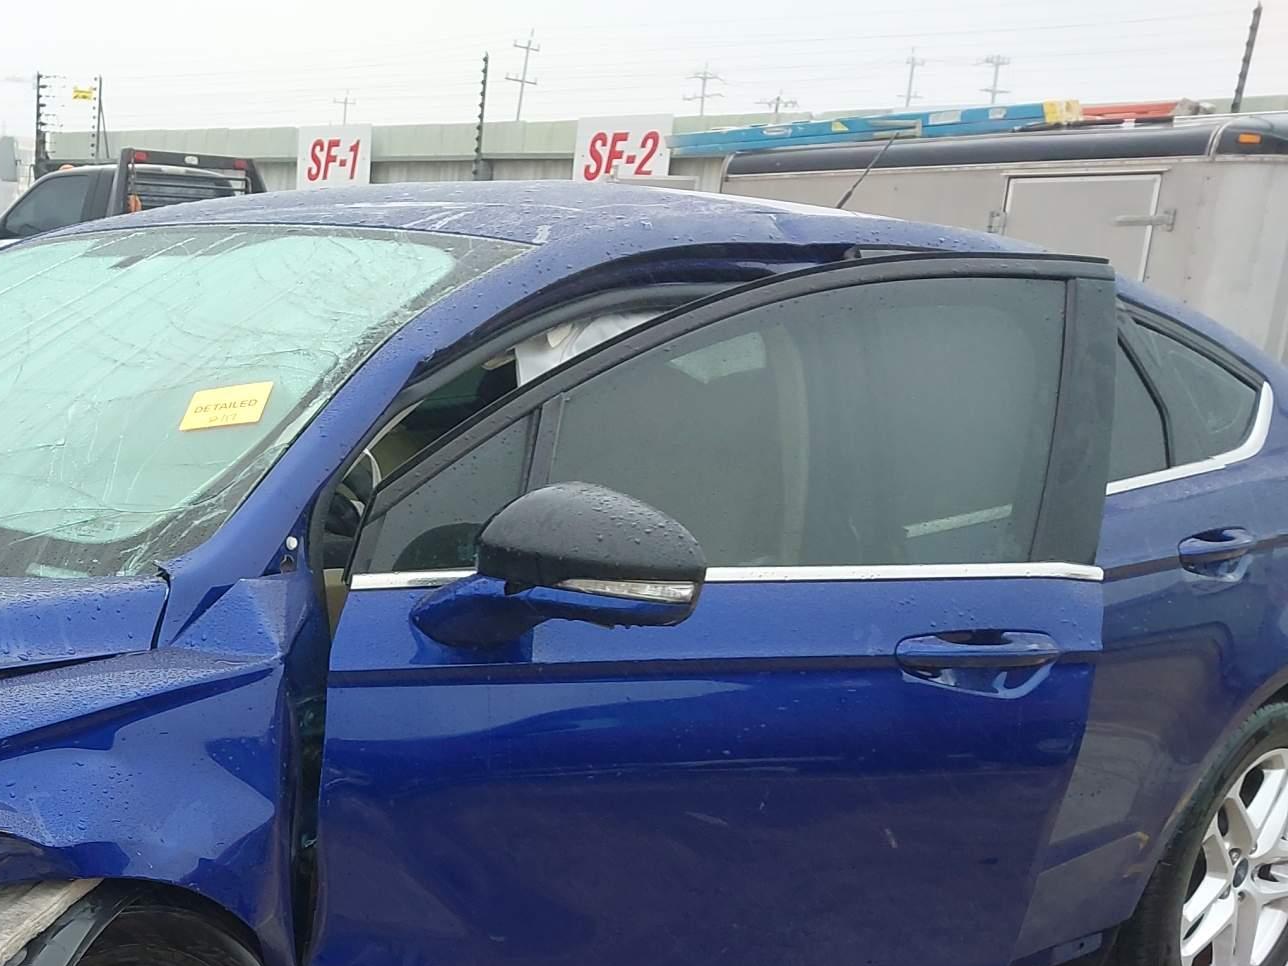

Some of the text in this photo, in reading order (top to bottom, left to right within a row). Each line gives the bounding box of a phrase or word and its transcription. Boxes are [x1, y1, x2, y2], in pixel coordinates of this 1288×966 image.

[307, 138, 361, 181] SF-1
[584, 130, 660, 181] SF-2
[194, 399, 258, 414] DETAILED
